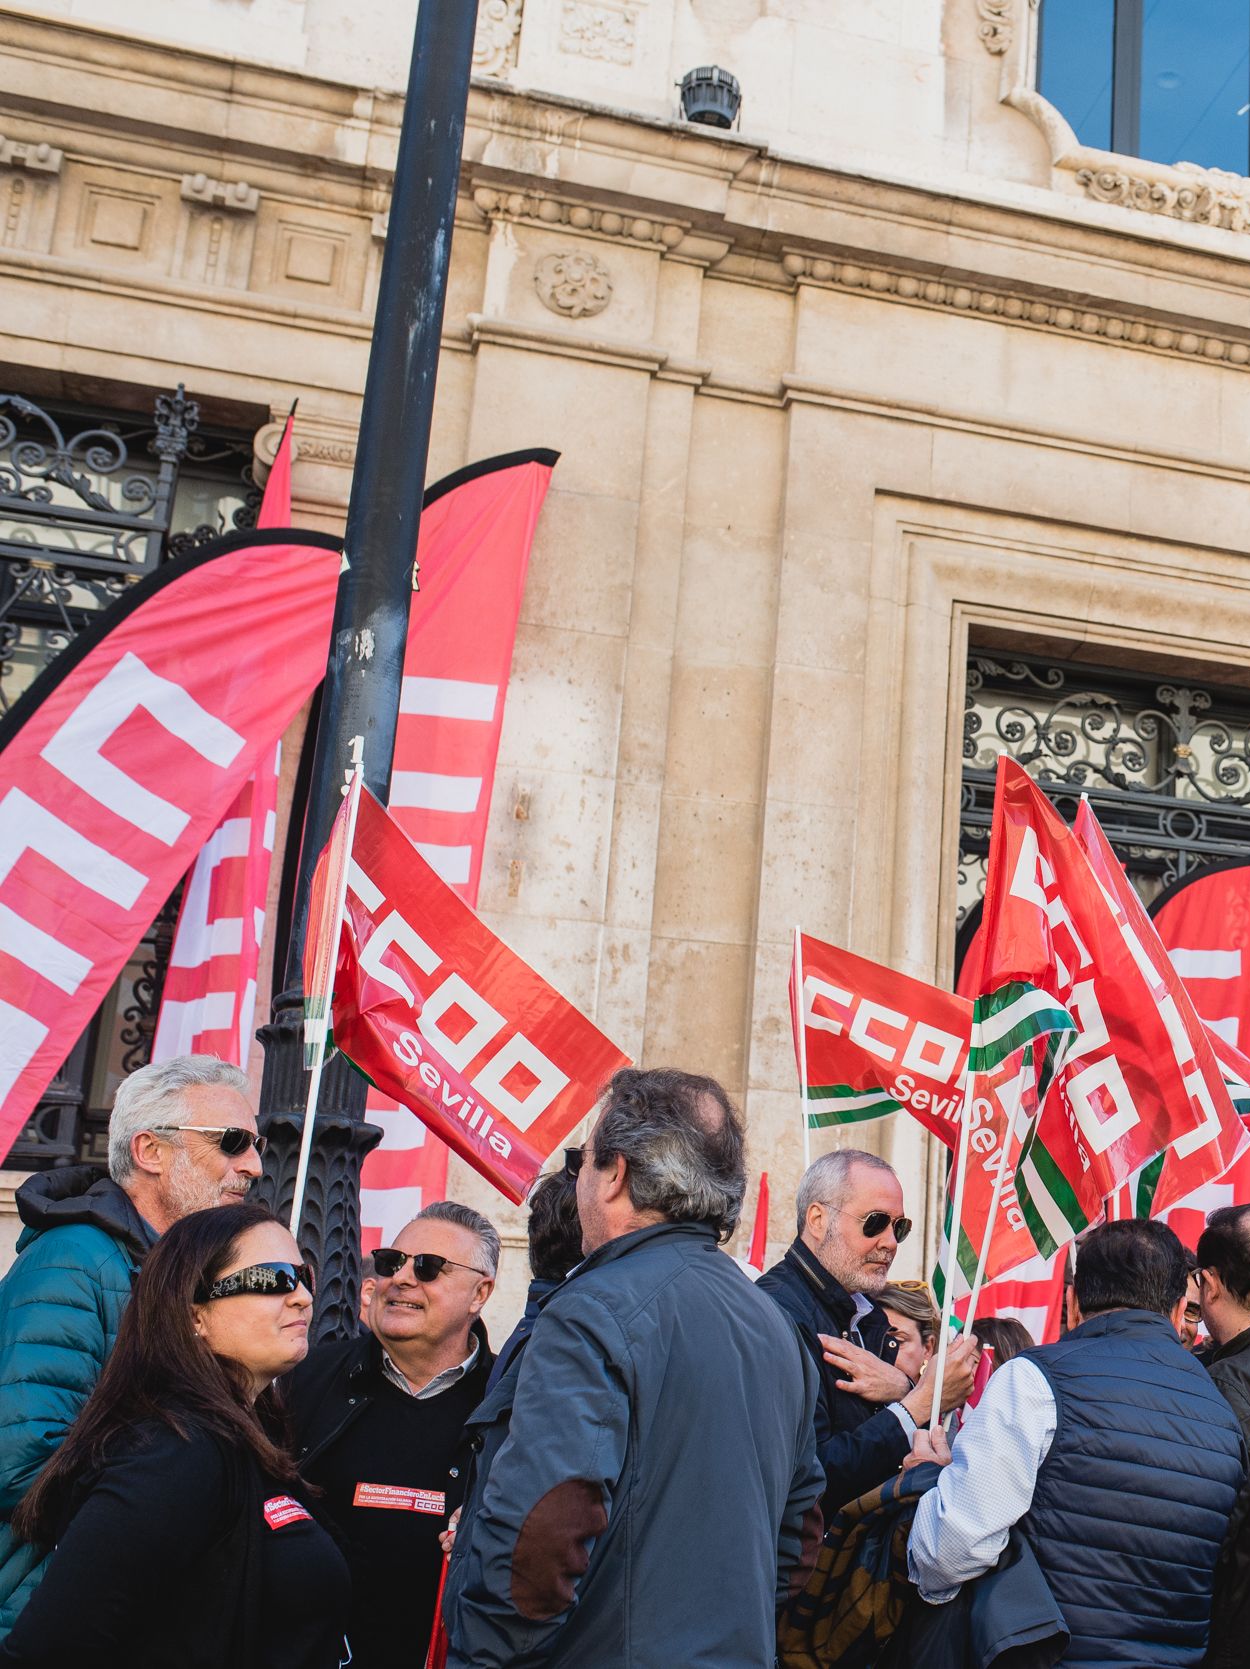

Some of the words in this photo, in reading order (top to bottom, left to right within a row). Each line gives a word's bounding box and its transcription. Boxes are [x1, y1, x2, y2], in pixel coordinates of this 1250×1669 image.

[803, 975, 966, 1091] CCO
[392, 1031, 514, 1160] Sevilla
[416, 1501, 445, 1512] CCOO
